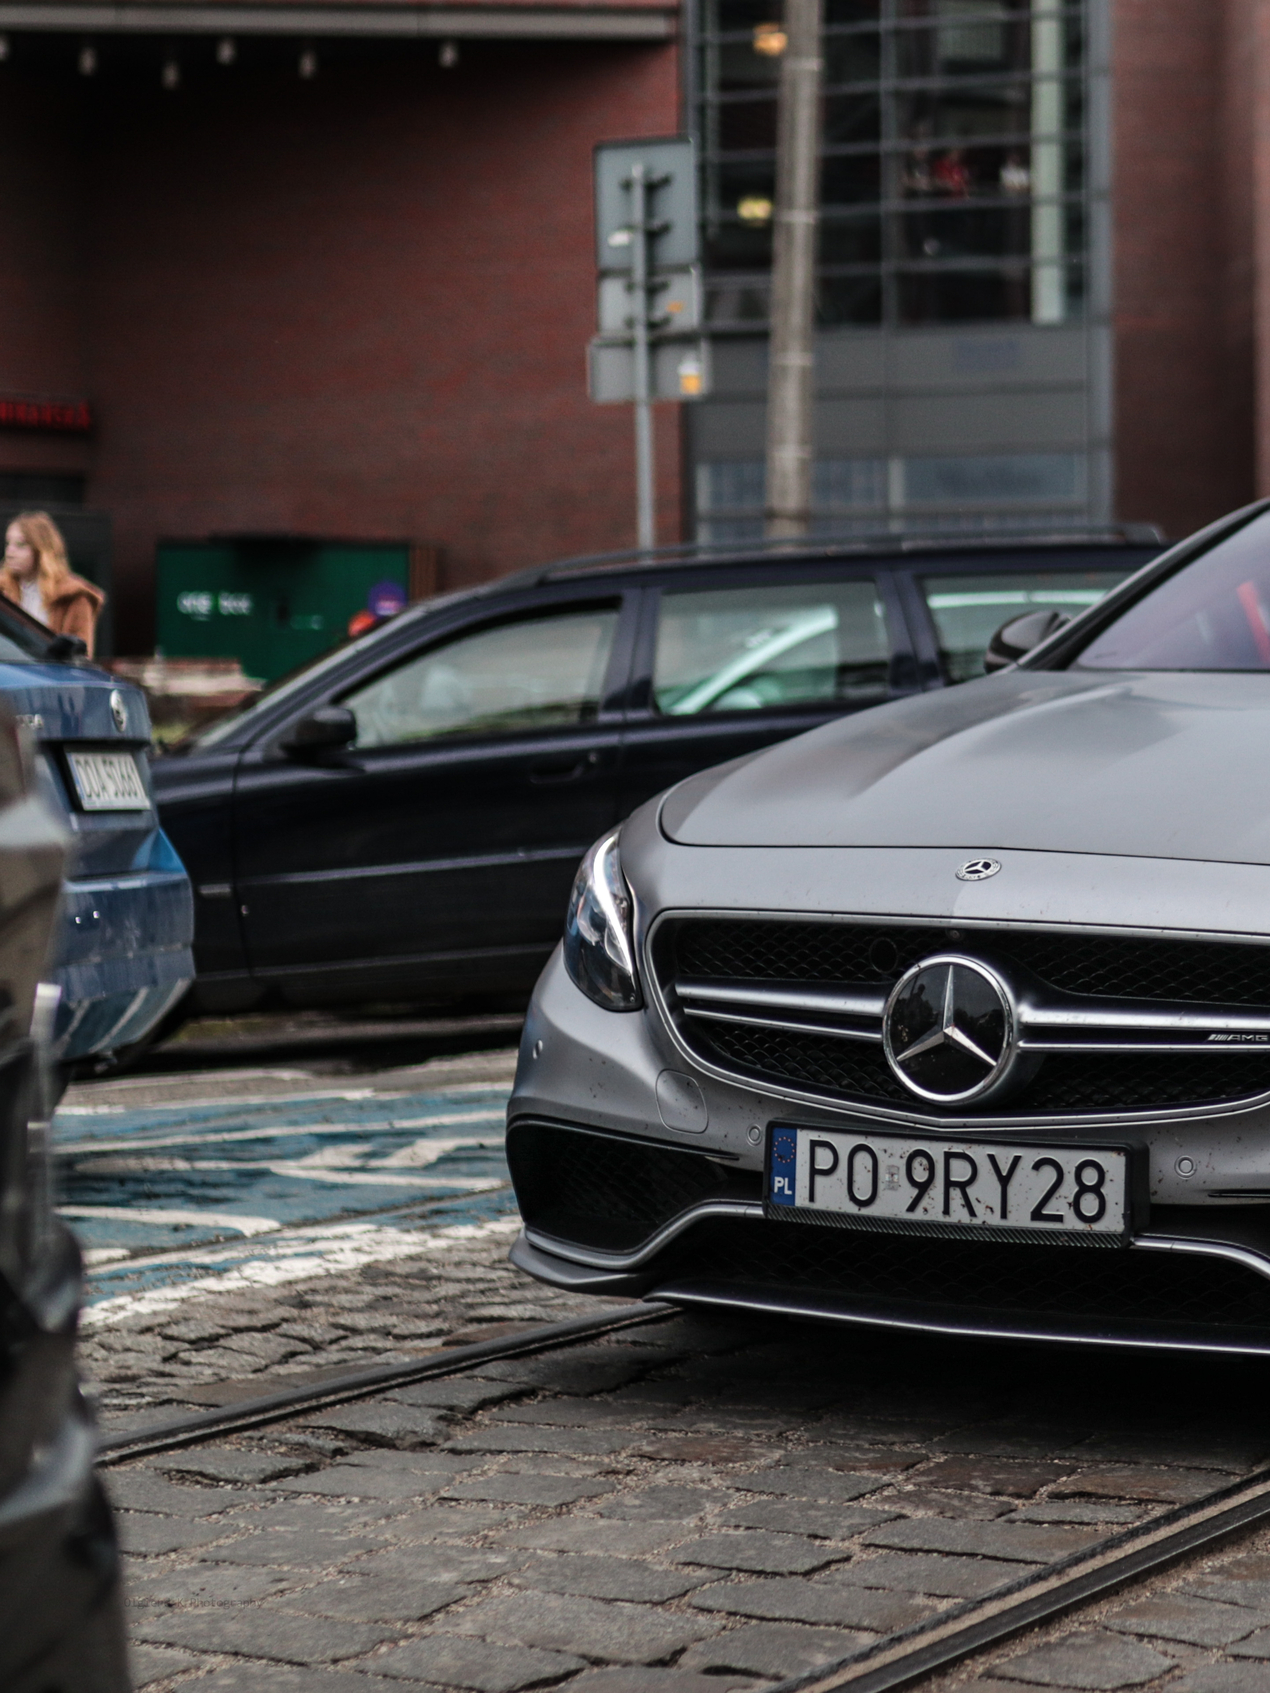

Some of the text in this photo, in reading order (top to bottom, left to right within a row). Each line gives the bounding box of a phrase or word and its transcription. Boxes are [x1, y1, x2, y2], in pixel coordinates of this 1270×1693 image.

[1227, 1034, 1268, 1042] AMG
[773, 1176, 792, 1195] PL
[809, 1138, 1107, 1224] PO 9RY28
